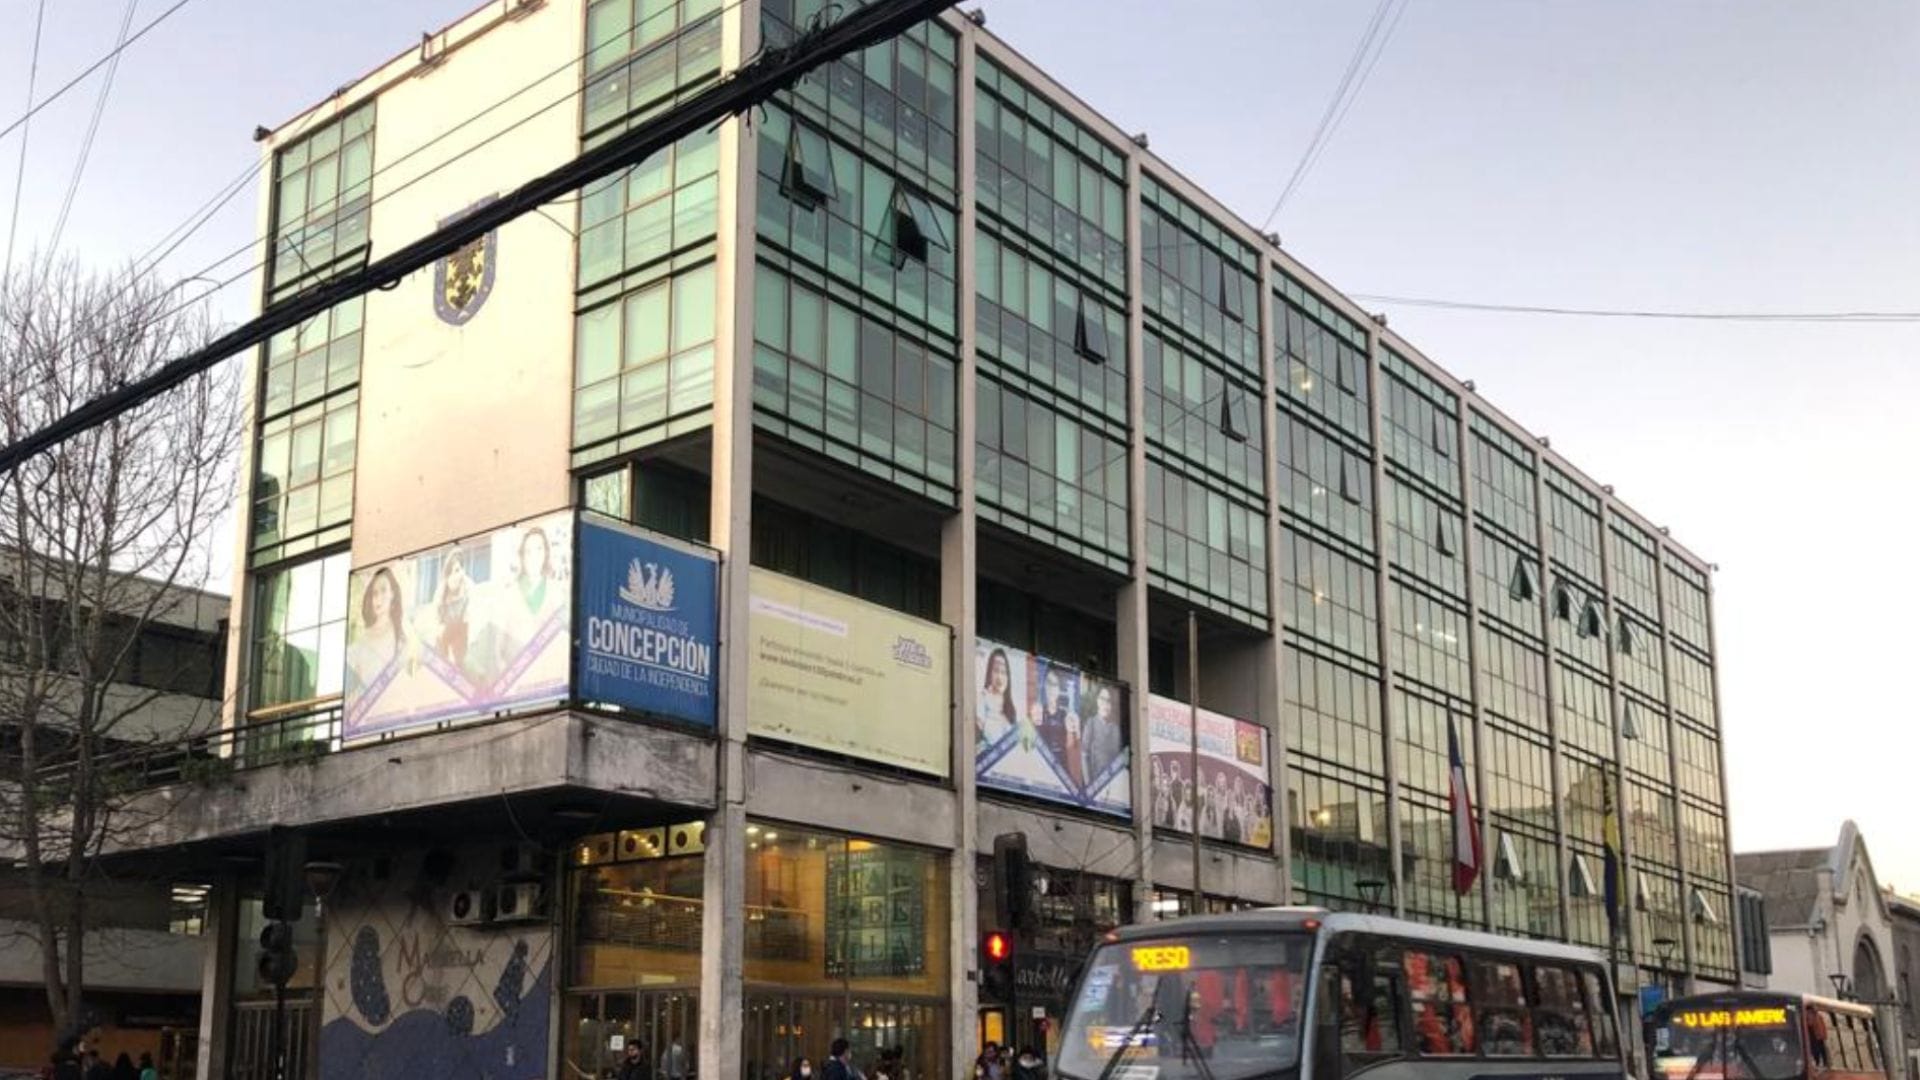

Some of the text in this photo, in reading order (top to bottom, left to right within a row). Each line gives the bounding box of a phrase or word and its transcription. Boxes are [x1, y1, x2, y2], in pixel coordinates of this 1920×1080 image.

[611, 602, 678, 633] MUNICIPALIDAD
[588, 616, 710, 676] CONCEPCIÓN
[587, 656, 709, 697] CIUDAD DE LA INDEPENDENCIA
[1684, 1011, 1697, 1027] U
[1699, 1010, 1730, 1027] LAS
